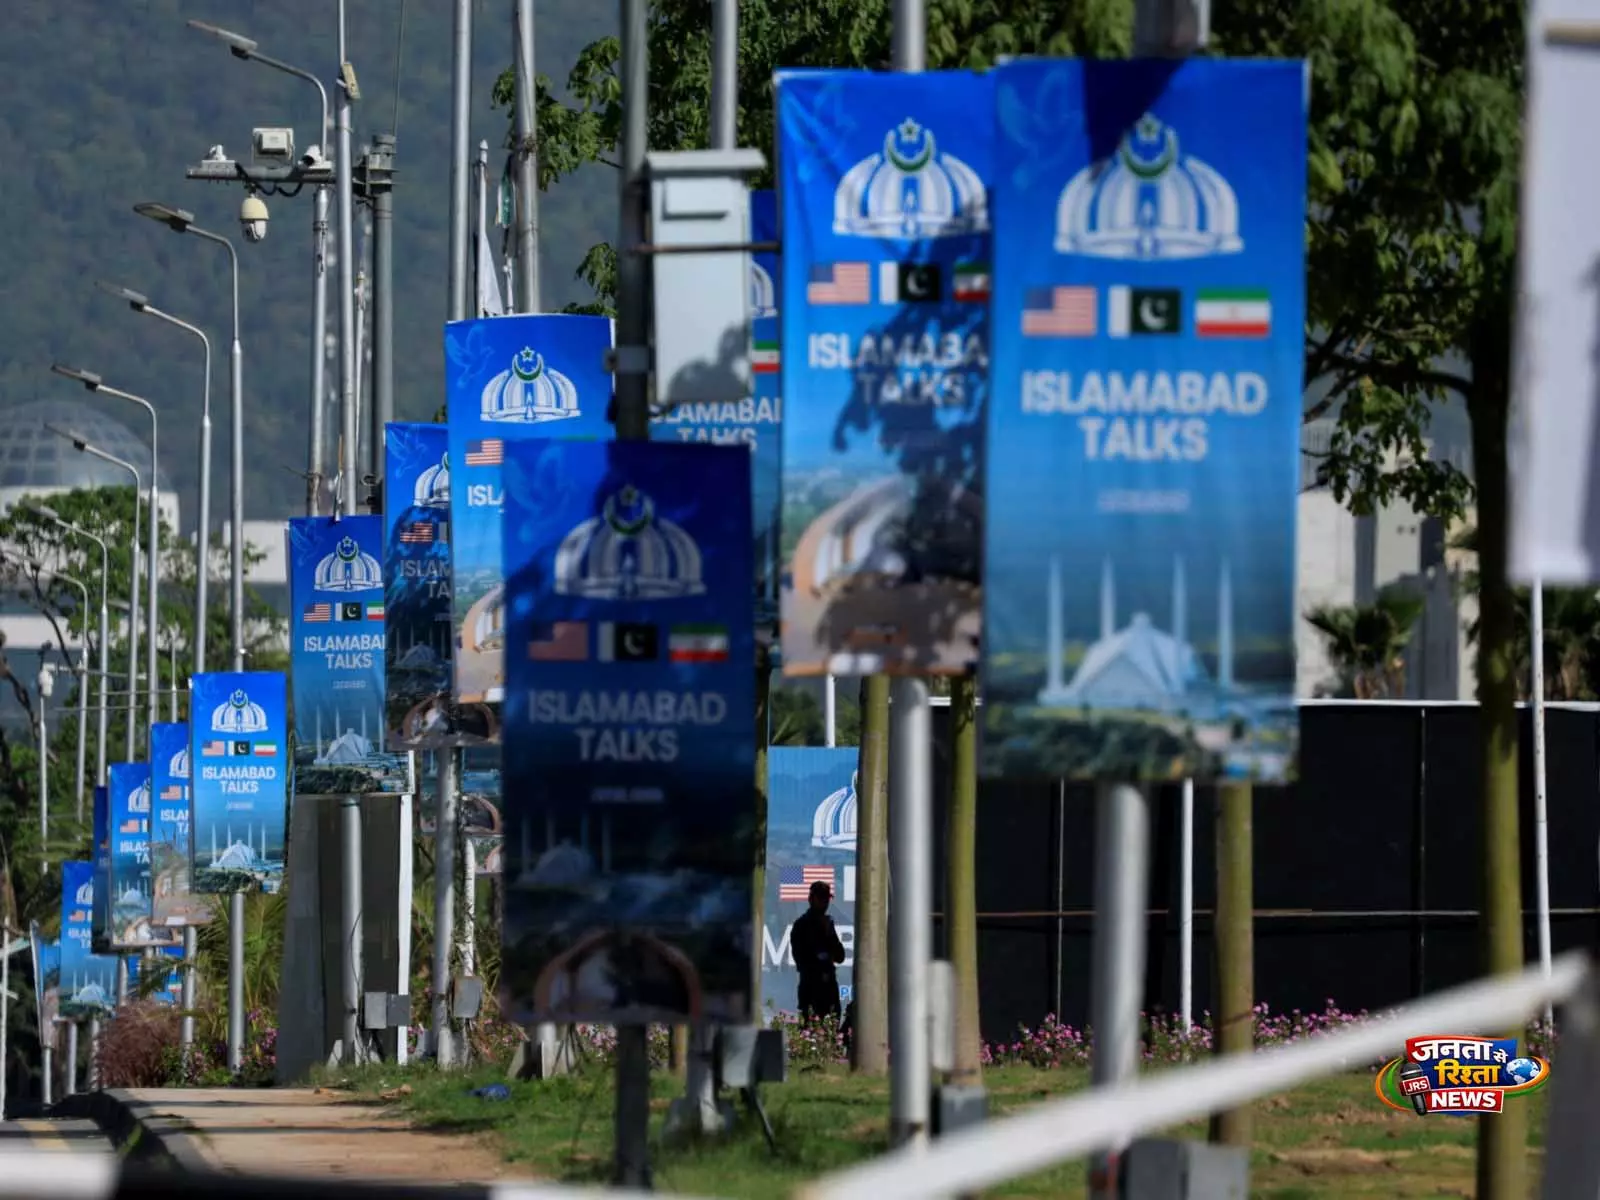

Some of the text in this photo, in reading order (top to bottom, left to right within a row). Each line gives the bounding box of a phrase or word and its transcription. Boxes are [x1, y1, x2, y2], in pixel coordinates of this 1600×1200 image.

[808, 332, 989, 369] ISLAMABA
[858, 371, 966, 407] TALKS
[1021, 369, 1268, 416] ISLAMABAD
[1078, 417, 1209, 461] TALKS
[325, 652, 373, 670] TALKS
[528, 689, 727, 724] ISLAMABAD
[574, 728, 680, 762] TALKS
[202, 765, 276, 780] ISLAMABAD
[220, 780, 259, 794] TALKS
